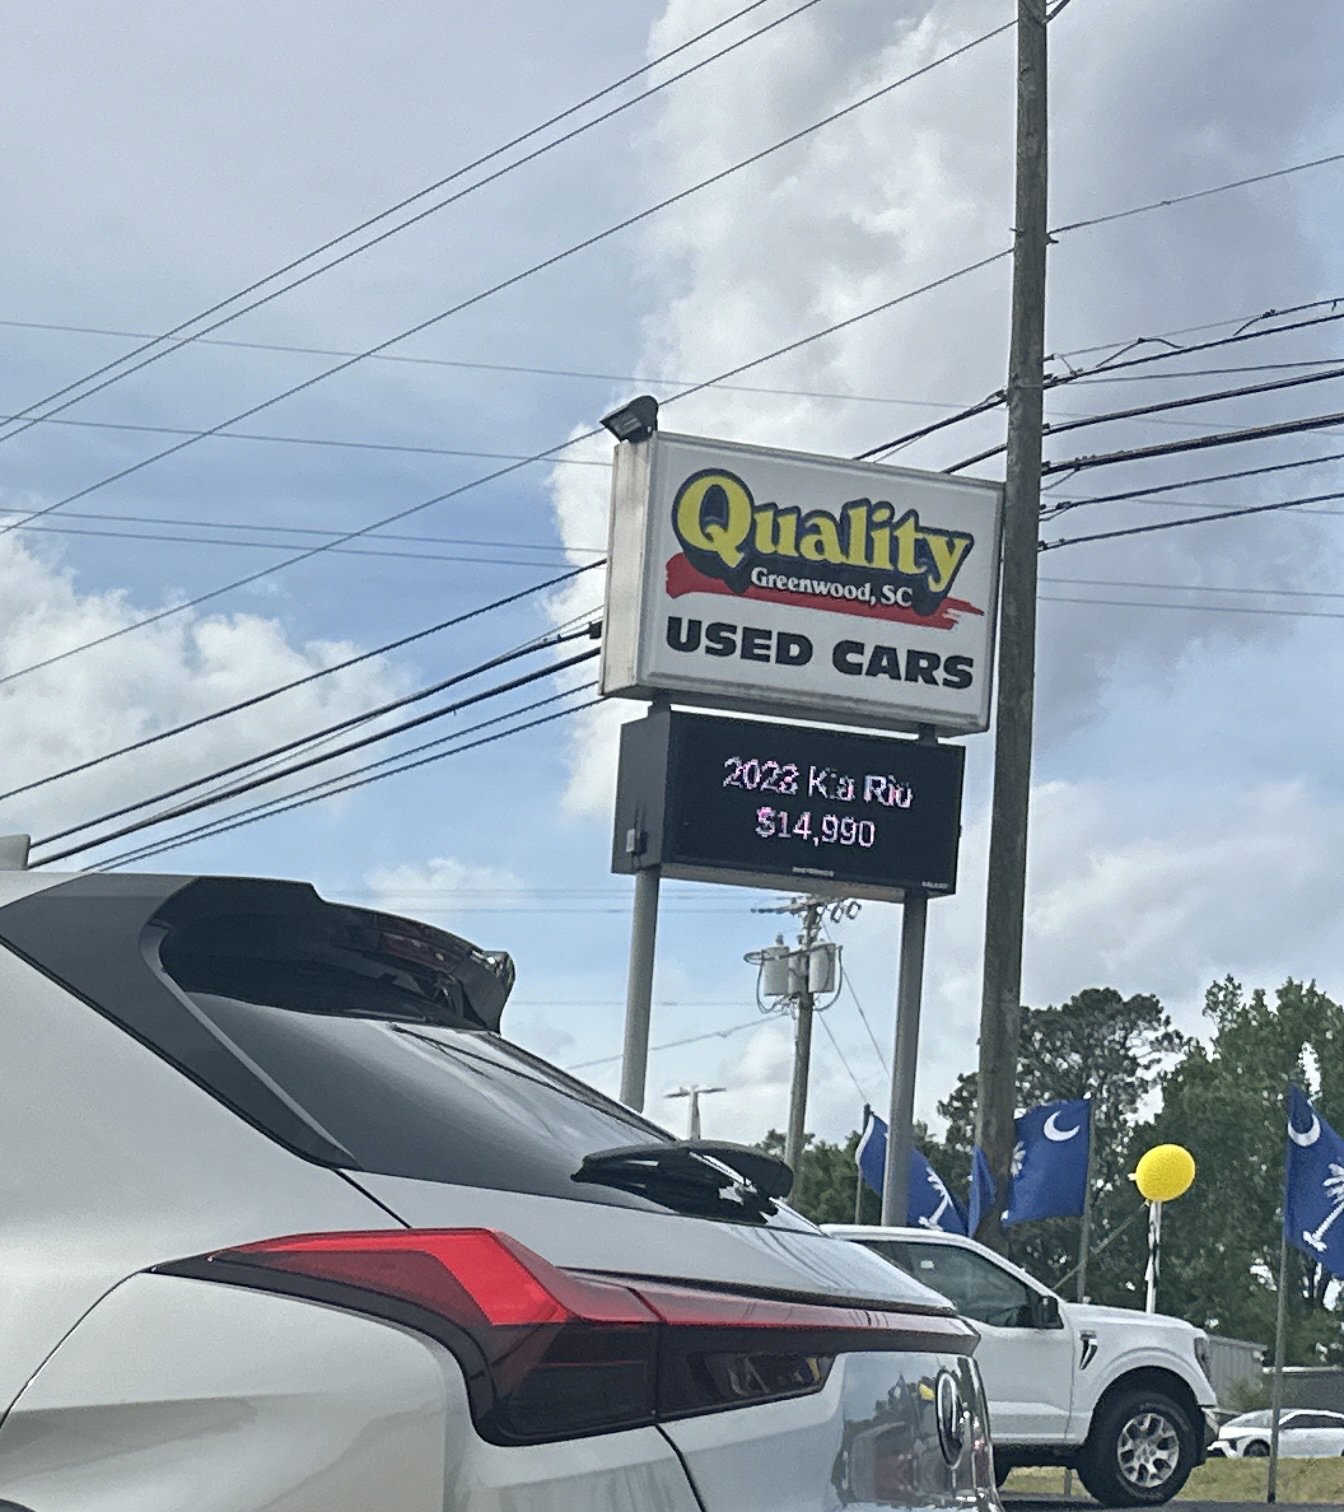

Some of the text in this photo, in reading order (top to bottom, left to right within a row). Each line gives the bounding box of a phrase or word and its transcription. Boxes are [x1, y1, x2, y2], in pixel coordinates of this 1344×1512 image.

[673, 469, 974, 596] Quality
[750, 567, 913, 607] Greenwood, SC
[666, 616, 974, 689] USED CARS
[807, 765, 855, 801] Kia
[755, 806, 875, 848] $14,990
